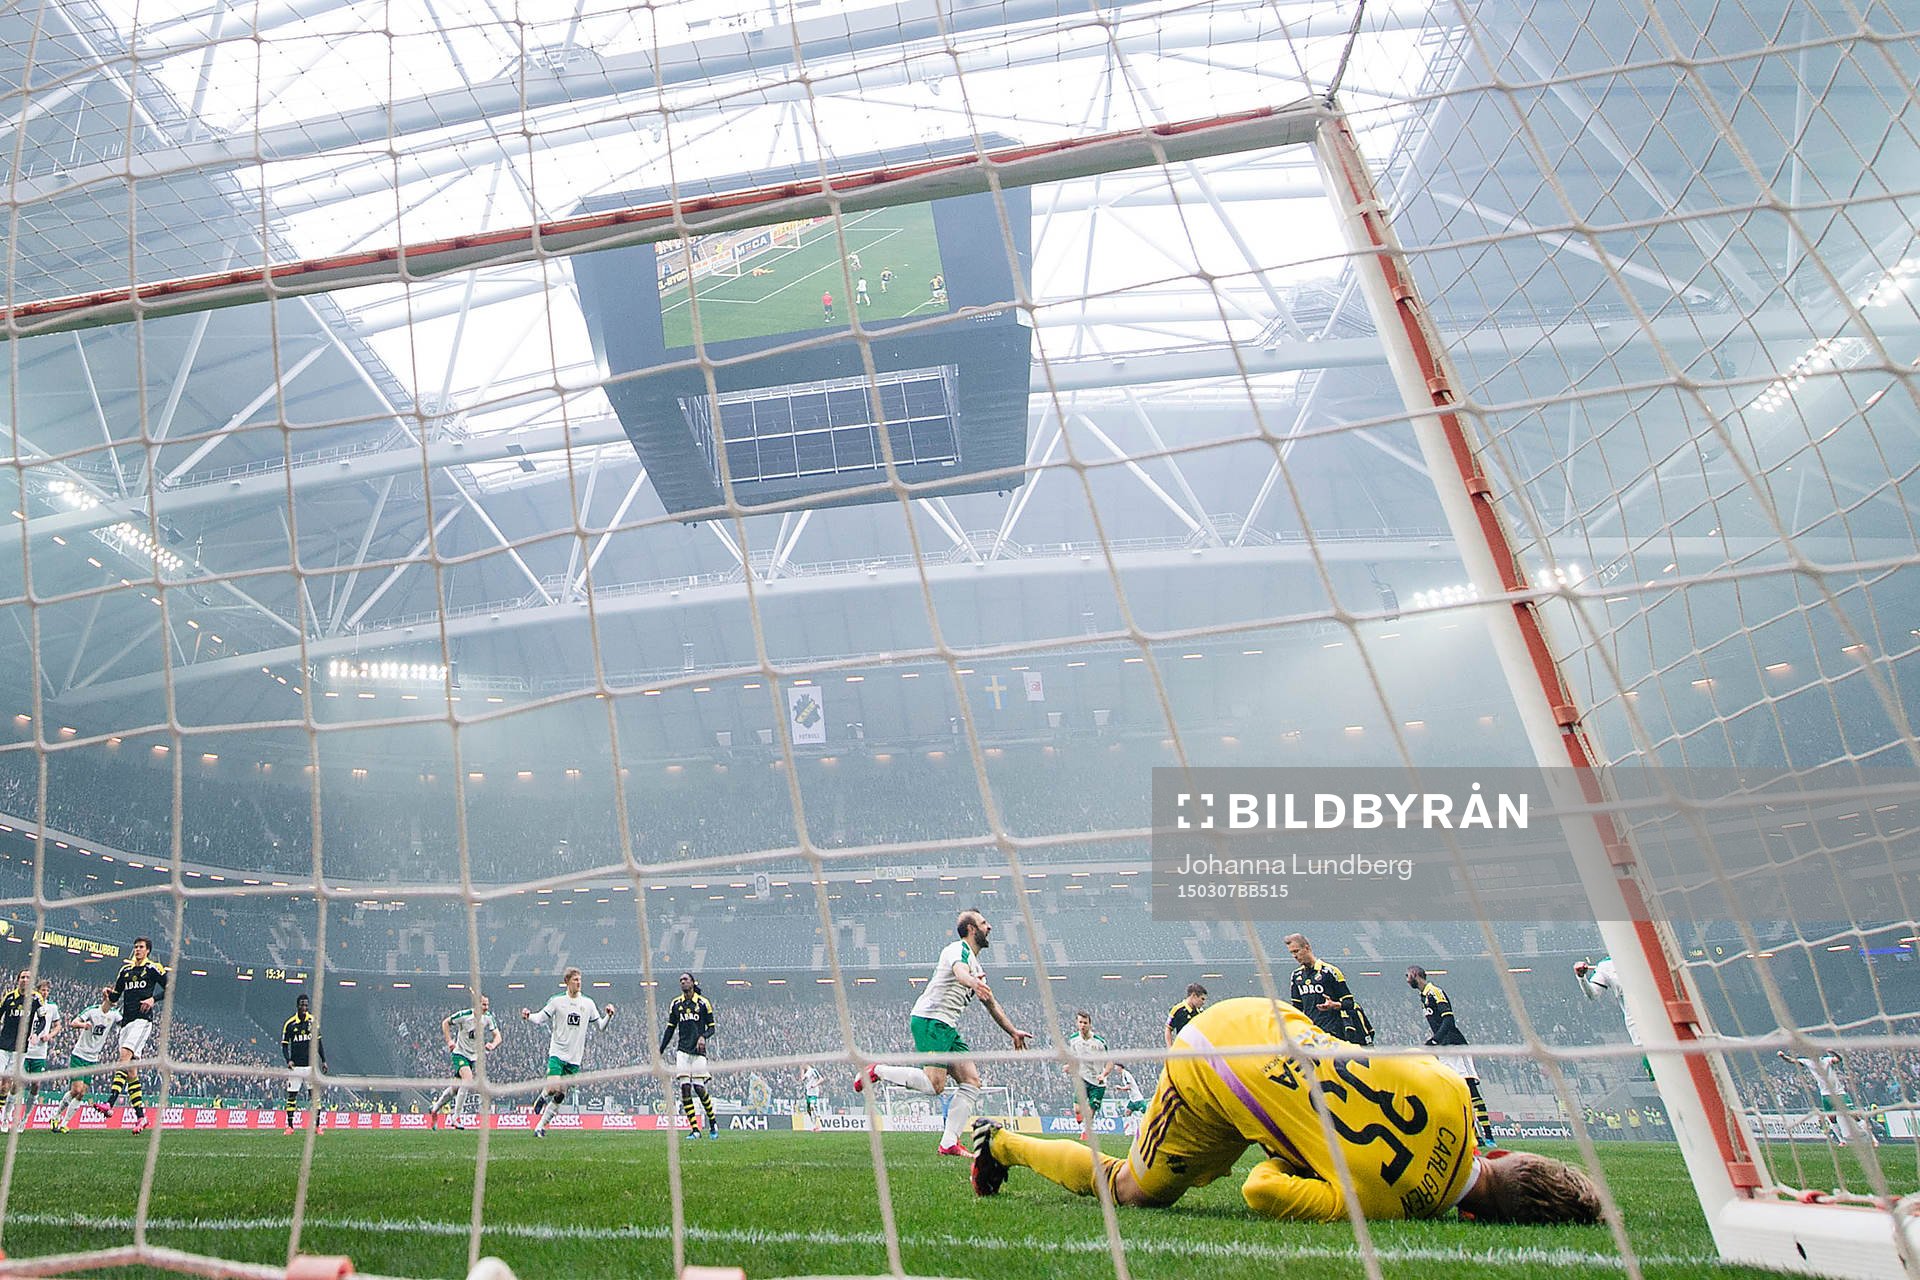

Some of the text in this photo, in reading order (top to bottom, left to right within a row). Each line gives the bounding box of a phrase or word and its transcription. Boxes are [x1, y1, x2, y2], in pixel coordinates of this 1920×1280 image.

[266, 968, 285, 979] 15:34
[730, 1116, 768, 1130] AKH
[819, 1116, 866, 1129] weber
[1310, 1054, 1429, 1186] 35
[1483, 1125, 1572, 1138] efina pantbank
[1400, 1127, 1457, 1221] CARLGREN
